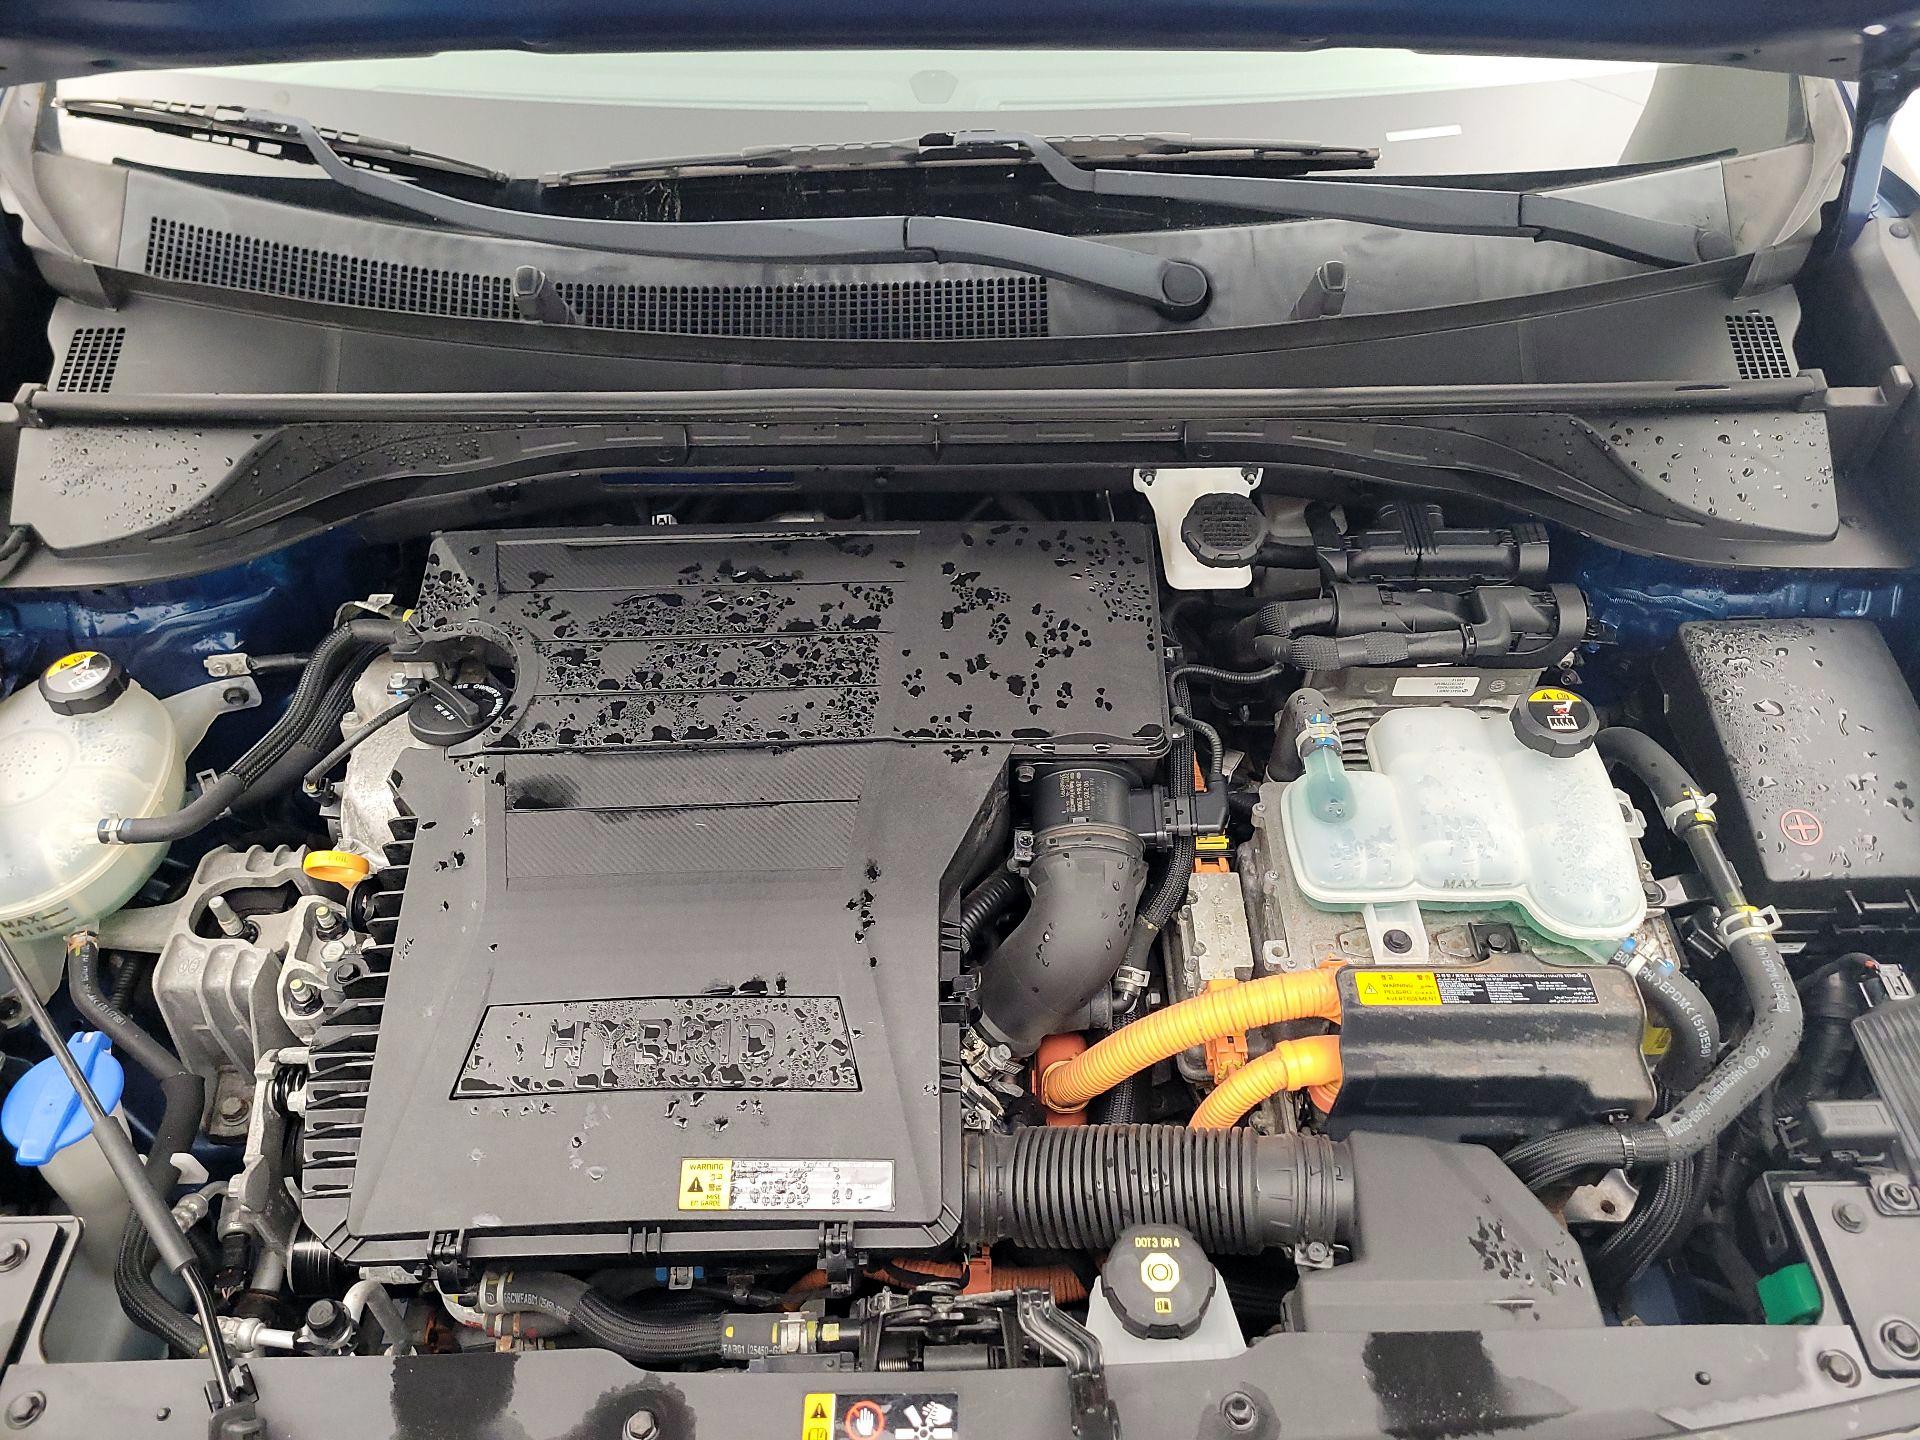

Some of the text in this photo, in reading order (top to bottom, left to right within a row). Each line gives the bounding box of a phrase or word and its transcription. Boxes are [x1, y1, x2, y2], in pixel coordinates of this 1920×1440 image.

[1442, 879, 1479, 889] MAX
[1, 915, 40, 929] MAX
[9, 925, 50, 938] MIN
[1638, 966, 1656, 982] PH
[543, 1018, 777, 1069] HYBRID
[689, 1163, 724, 1171] WARNING
